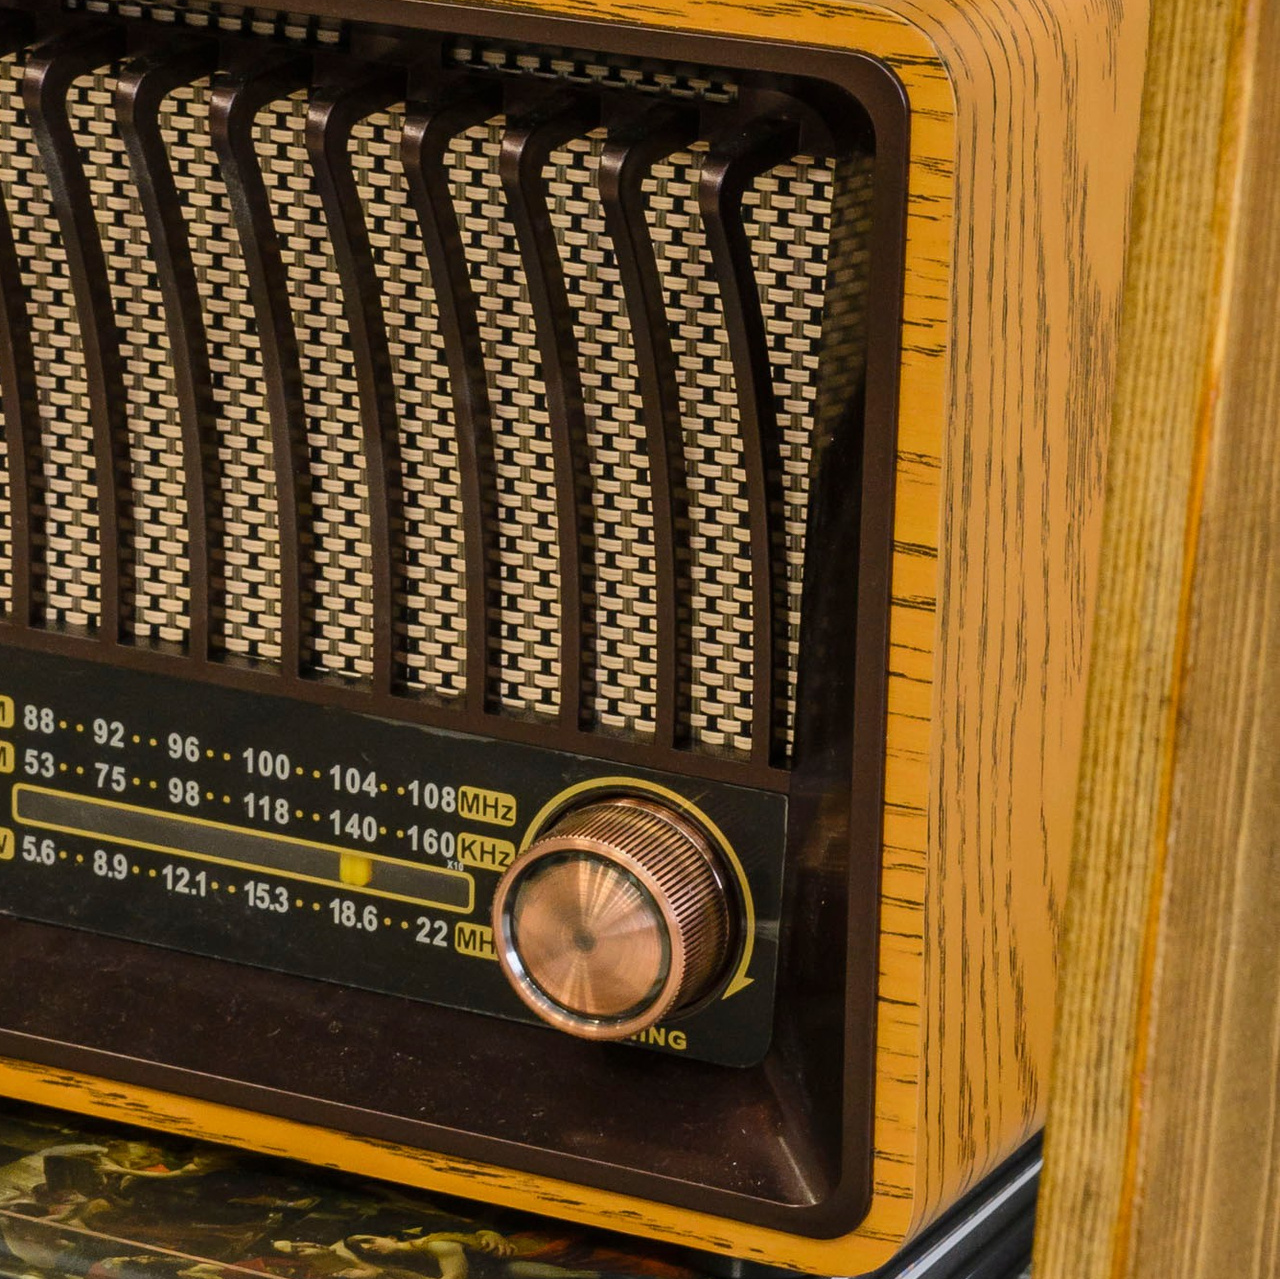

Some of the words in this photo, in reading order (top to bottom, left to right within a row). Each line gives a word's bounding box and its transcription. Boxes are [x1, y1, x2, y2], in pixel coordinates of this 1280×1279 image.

[23, 704, 55, 734] 88
[93, 718, 125, 748] 92
[168, 732, 200, 763] 96
[242, 747, 291, 780] 100
[329, 764, 378, 798] 104
[407, 780, 457, 813] 108
[459, 789, 515, 822] MHz
[23, 748, 55, 778] 53
[94, 762, 127, 792] 75
[168, 777, 200, 807] 98
[243, 792, 290, 824] 118
[329, 809, 378, 842] 140
[407, 825, 456, 858] 160
[460, 838, 512, 868] KHz
[22, 835, 56, 866] 5.6
[93, 849, 129, 881] 8.9
[162, 864, 207, 898] 12.1
[243, 880, 290, 913] 15.3
[329, 898, 378, 932] 18.6
[415, 916, 449, 948] 22
[456, 929, 496, 955] MH
